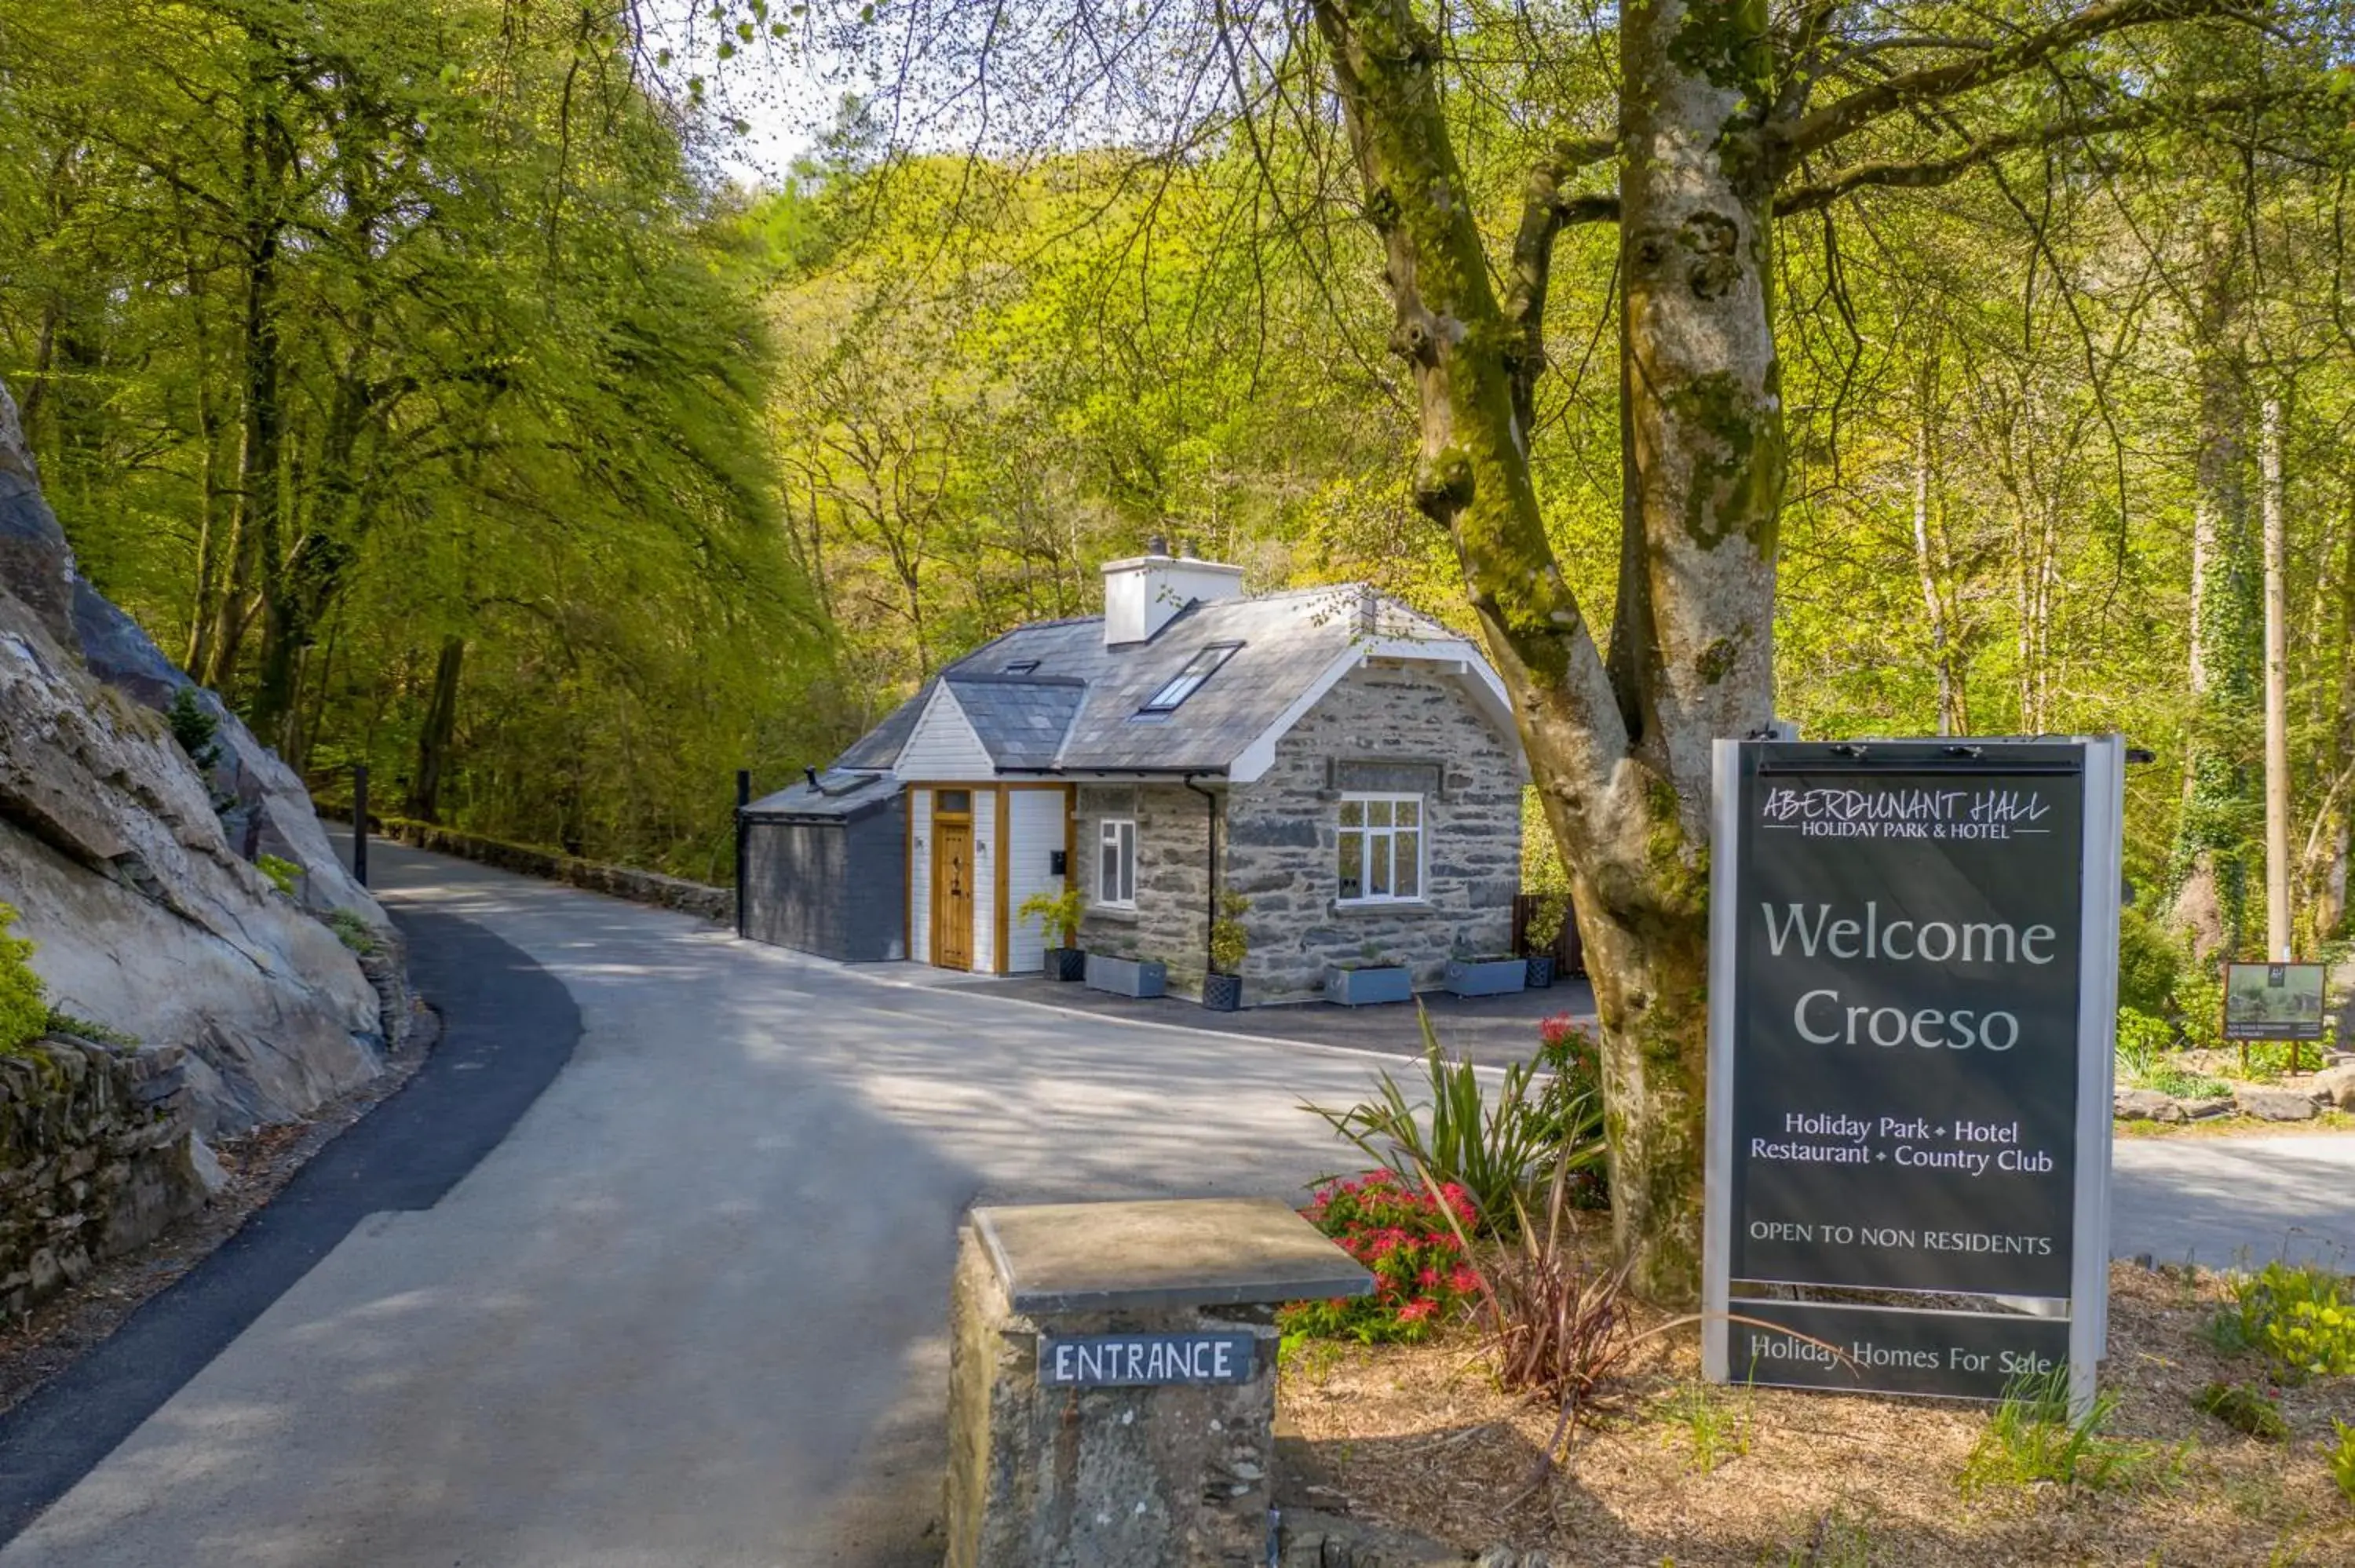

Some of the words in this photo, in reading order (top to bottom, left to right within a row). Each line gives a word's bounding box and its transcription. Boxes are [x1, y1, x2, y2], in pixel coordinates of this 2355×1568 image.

[1763, 787, 1967, 821] ABERDUNANT
[1970, 789, 2051, 823] HALL
[1802, 821, 1879, 837] HOLIDAY
[1883, 822, 1929, 837] PARK
[1933, 824, 1947, 838] &
[1951, 824, 2010, 839] HOTEL
[1762, 901, 2056, 965] Welcome
[1794, 990, 2019, 1051] Croeso
[1785, 1113, 1871, 1142] Holiday
[1880, 1117, 1930, 1140] Park
[1955, 1121, 2017, 1143] Hotel
[1751, 1139, 1870, 1164] Restaurant
[1895, 1145, 1990, 1176] Country
[1998, 1150, 2053, 1172] Club
[1751, 1221, 1812, 1242] OPEN
[1821, 1225, 1853, 1244] TO
[1861, 1228, 1915, 1248] NON
[1924, 1231, 2051, 1256] RESIDENTS
[1055, 1341, 1232, 1381] ENTRANCE
[1751, 1334, 1844, 1370] Holiday
[1853, 1341, 1941, 1369] Homes
[1950, 1347, 1991, 1372] For
[1999, 1350, 2052, 1376] Sale
